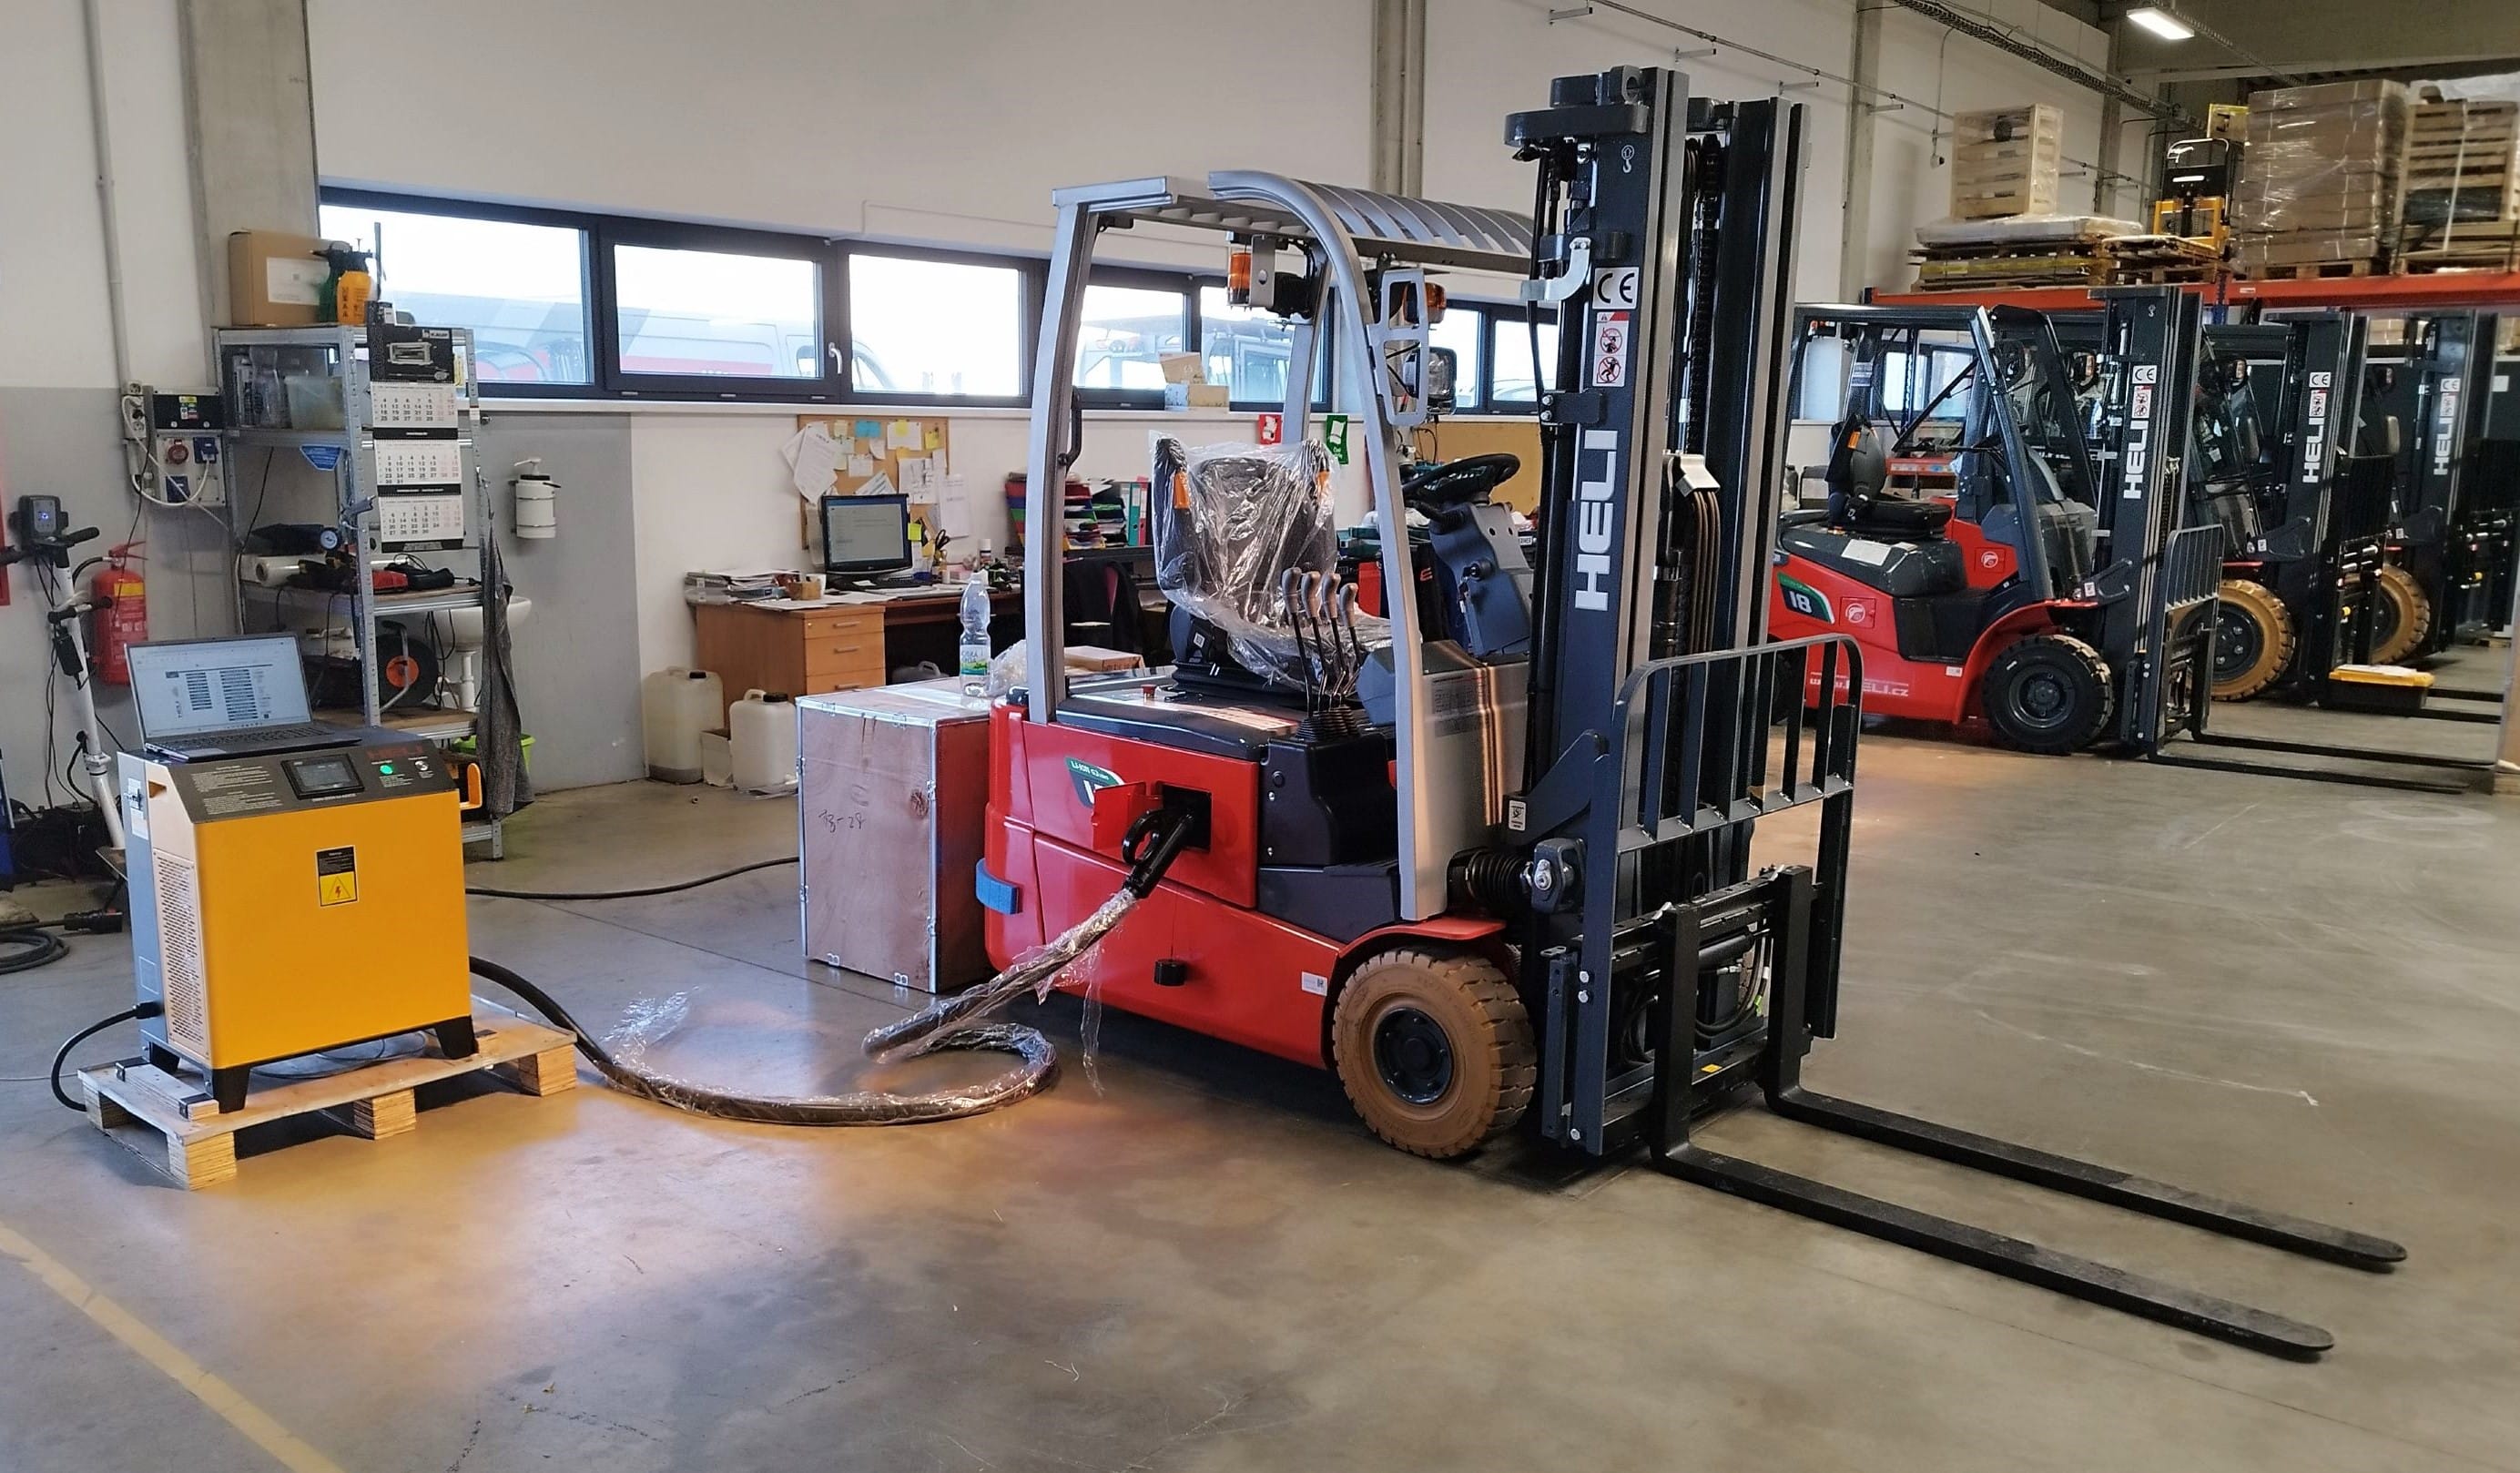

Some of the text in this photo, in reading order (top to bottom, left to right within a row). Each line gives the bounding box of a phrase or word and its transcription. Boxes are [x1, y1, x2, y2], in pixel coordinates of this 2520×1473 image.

[1597, 272, 1635, 304] CE
[2134, 368, 2155, 381] CE
[2312, 373, 2330, 386] CE
[2123, 420, 2149, 500] HELI
[2302, 418, 2325, 483] HELI
[2433, 417, 2454, 475] HELI
[1574, 429, 1619, 612] HELI
[1789, 590, 1813, 614] 18
